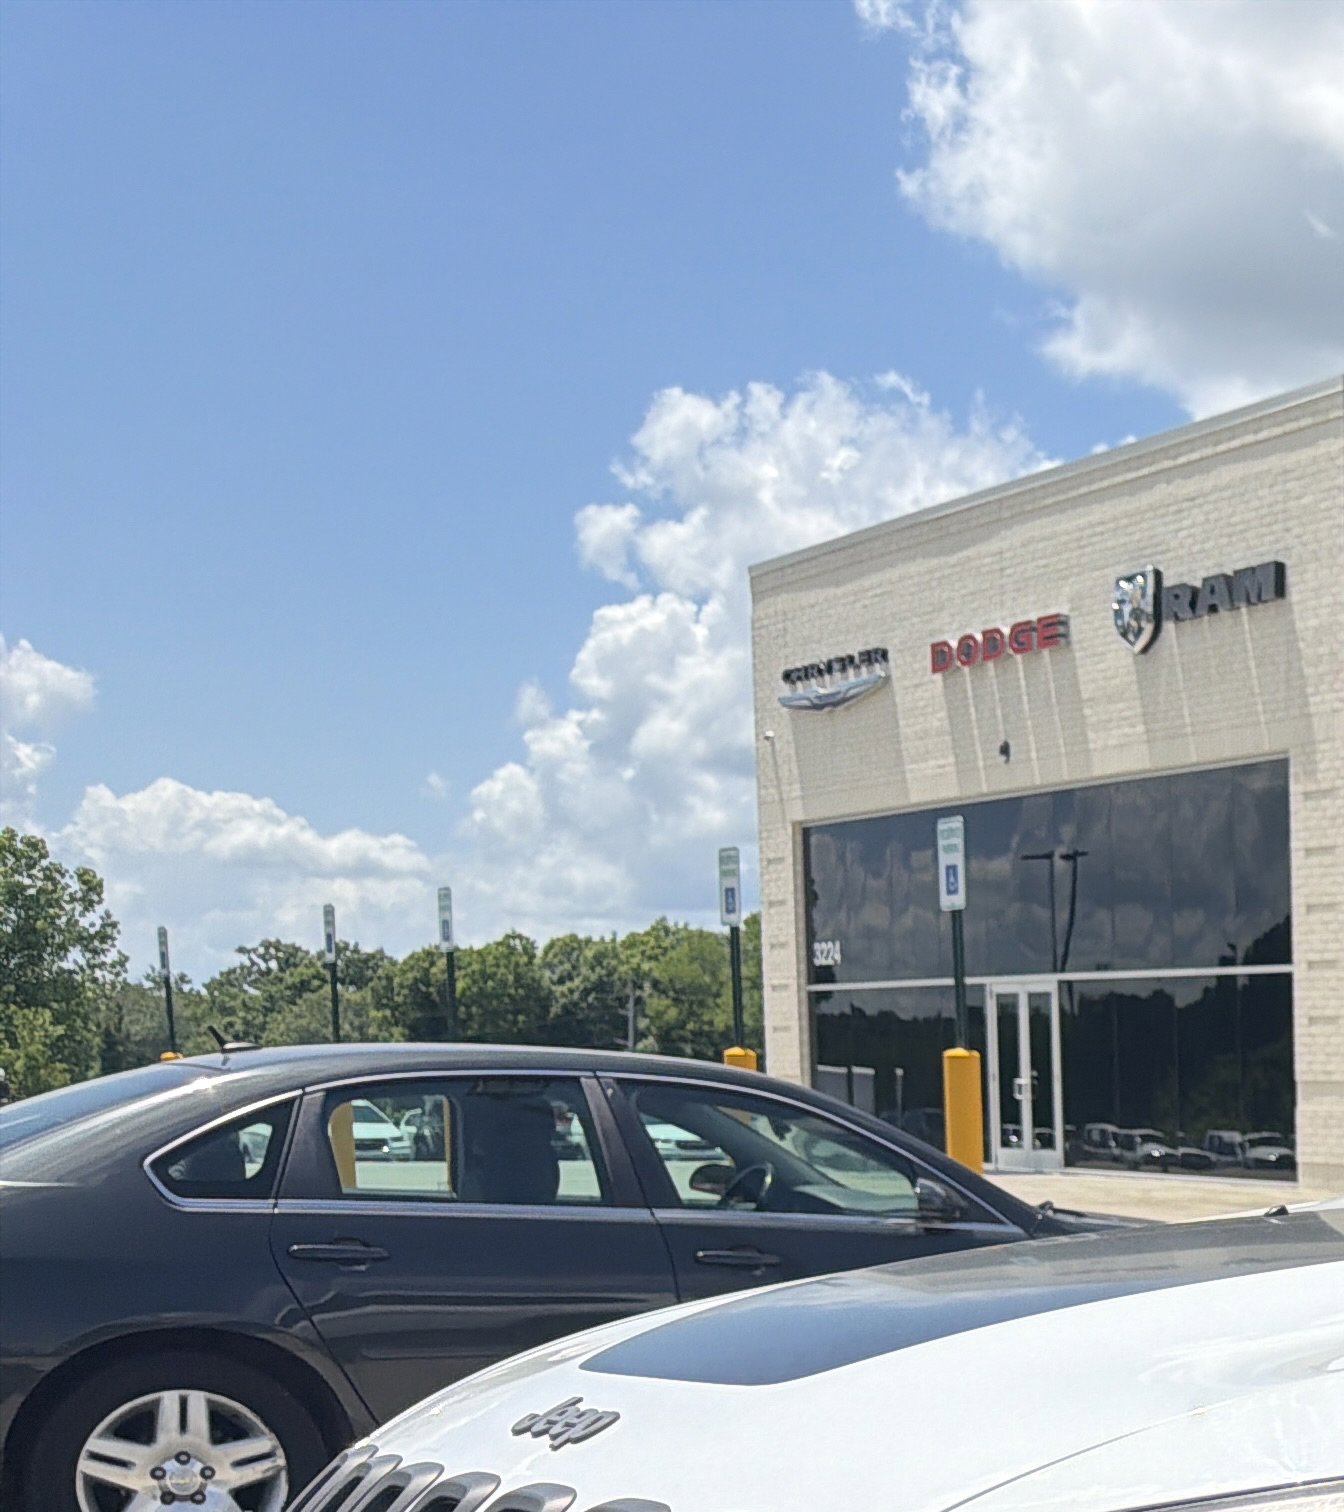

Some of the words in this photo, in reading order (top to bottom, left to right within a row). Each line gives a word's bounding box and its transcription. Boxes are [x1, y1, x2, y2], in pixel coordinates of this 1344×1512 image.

[1162, 561, 1287, 622] RAM
[931, 612, 1069, 674] DODGE
[813, 940, 841, 966] 3224
[511, 1397, 620, 1451] Jeep
